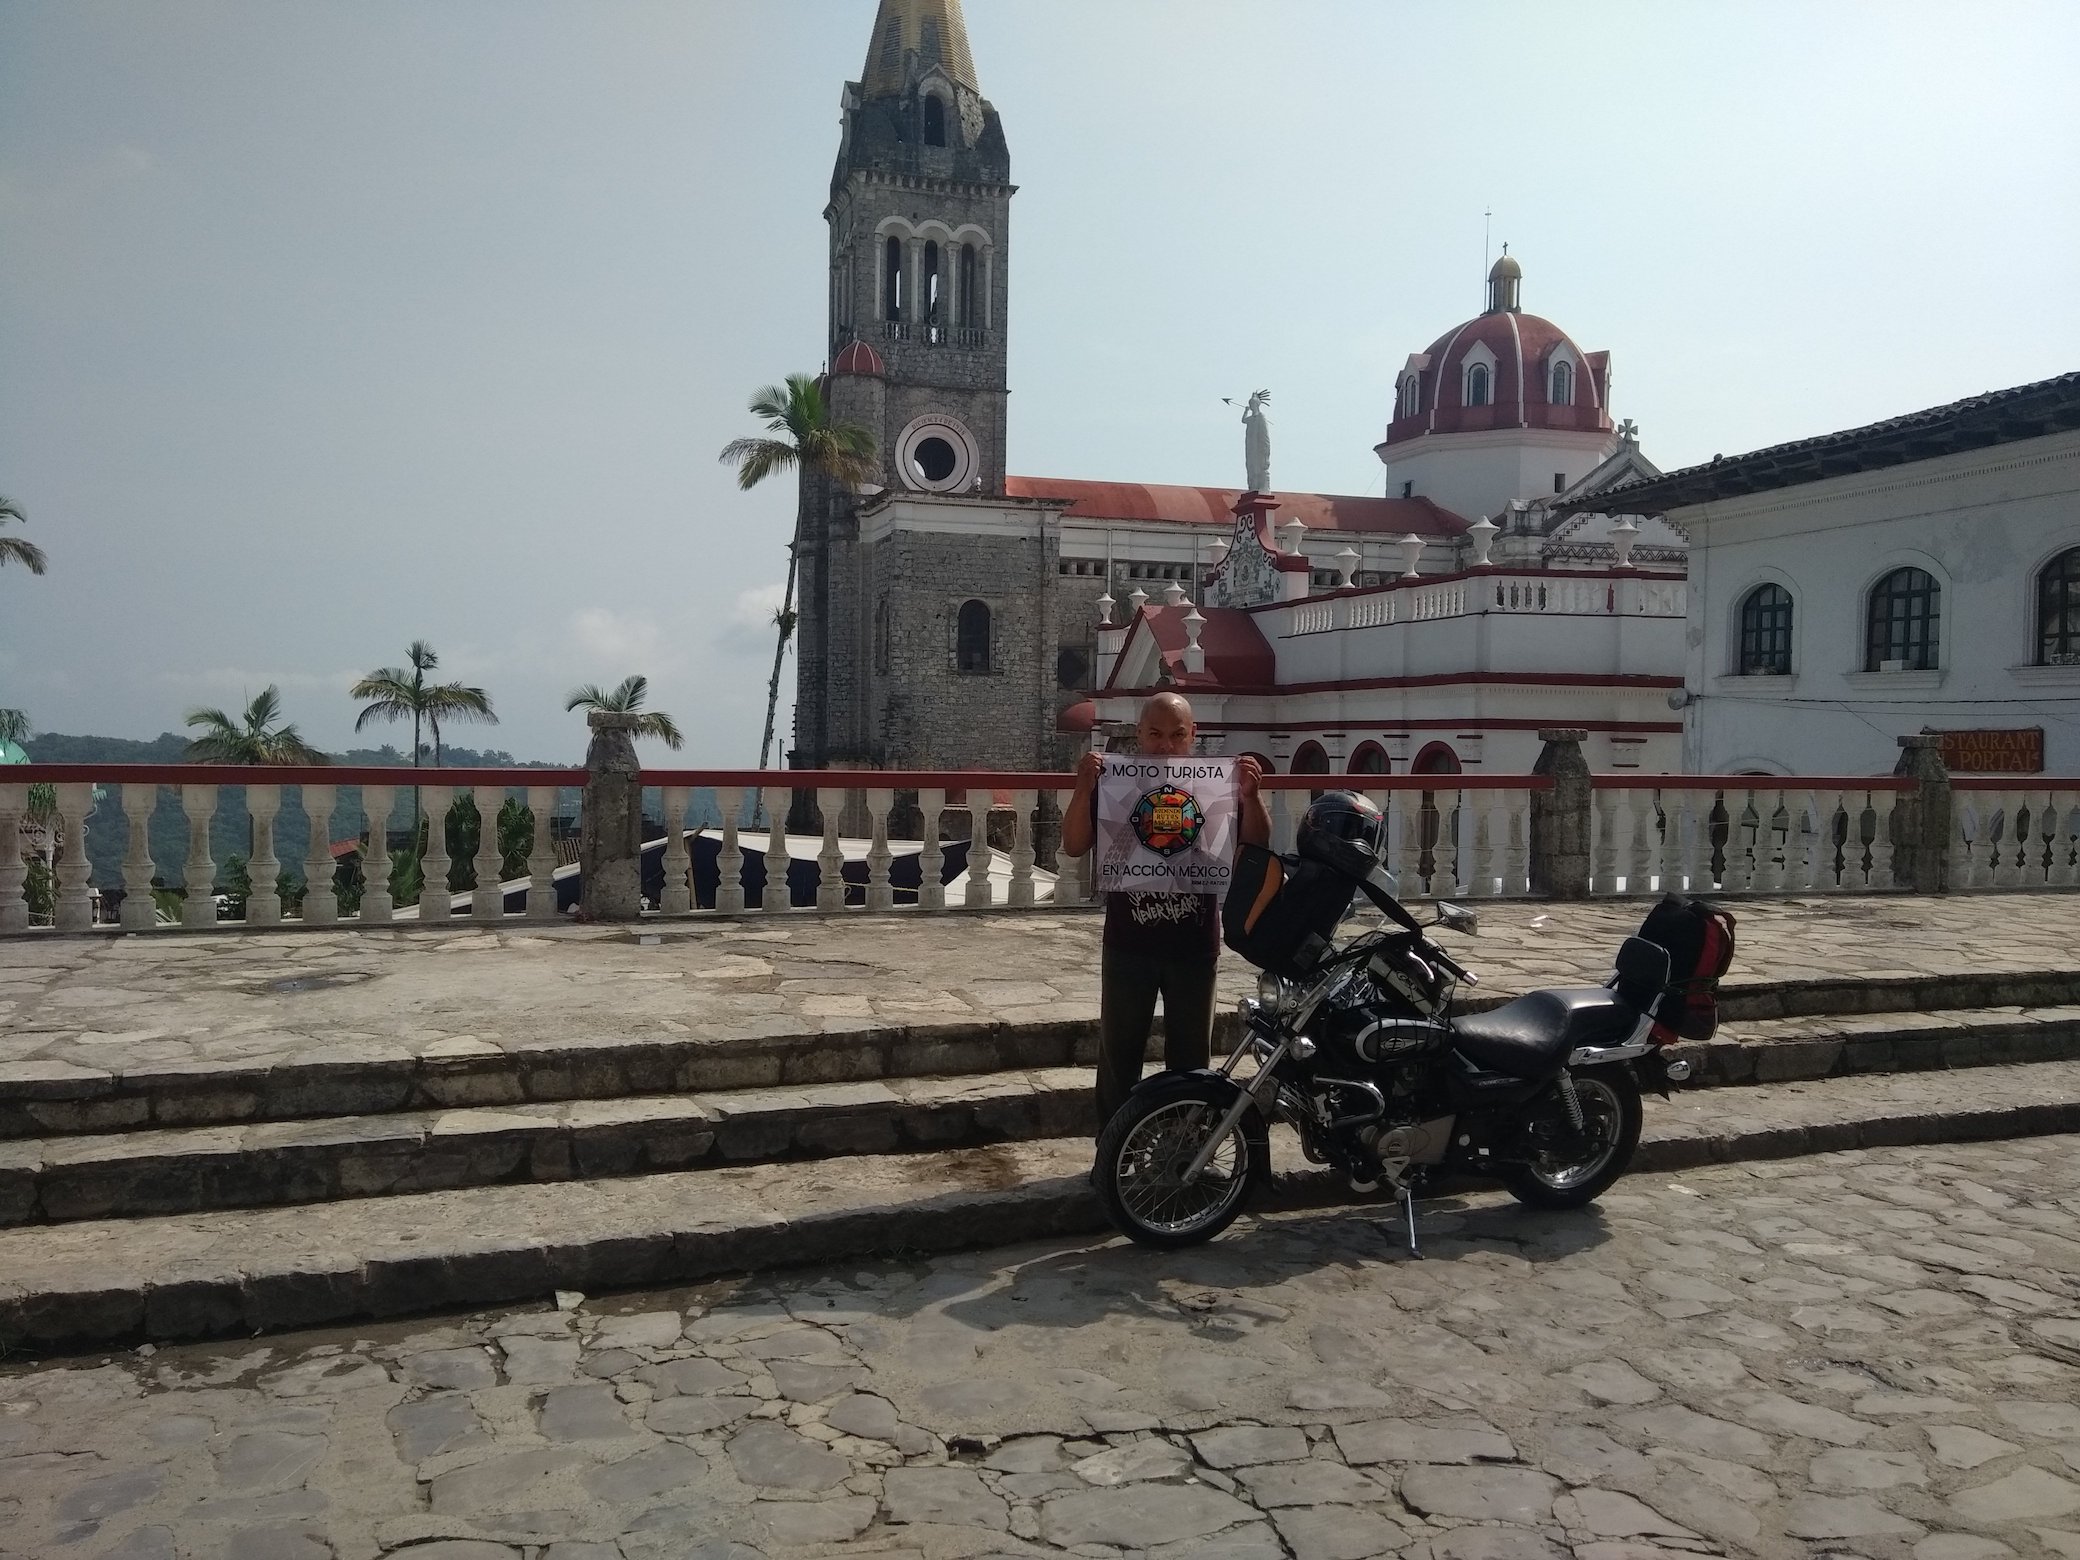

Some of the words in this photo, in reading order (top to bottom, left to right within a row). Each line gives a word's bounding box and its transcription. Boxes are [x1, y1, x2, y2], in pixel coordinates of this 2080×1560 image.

[1943, 732, 2040, 751] STAURANT
[1959, 751, 2037, 771] PORTAL
[1112, 764, 1160, 778] MOTO
[1164, 766, 1224, 779] TURISTA
[1103, 864, 1119, 876] EN
[1123, 862, 1175, 877] ACCIÓN
[1180, 863, 1230, 878] MÉXICO
[1132, 903, 1168, 925] NEVER
